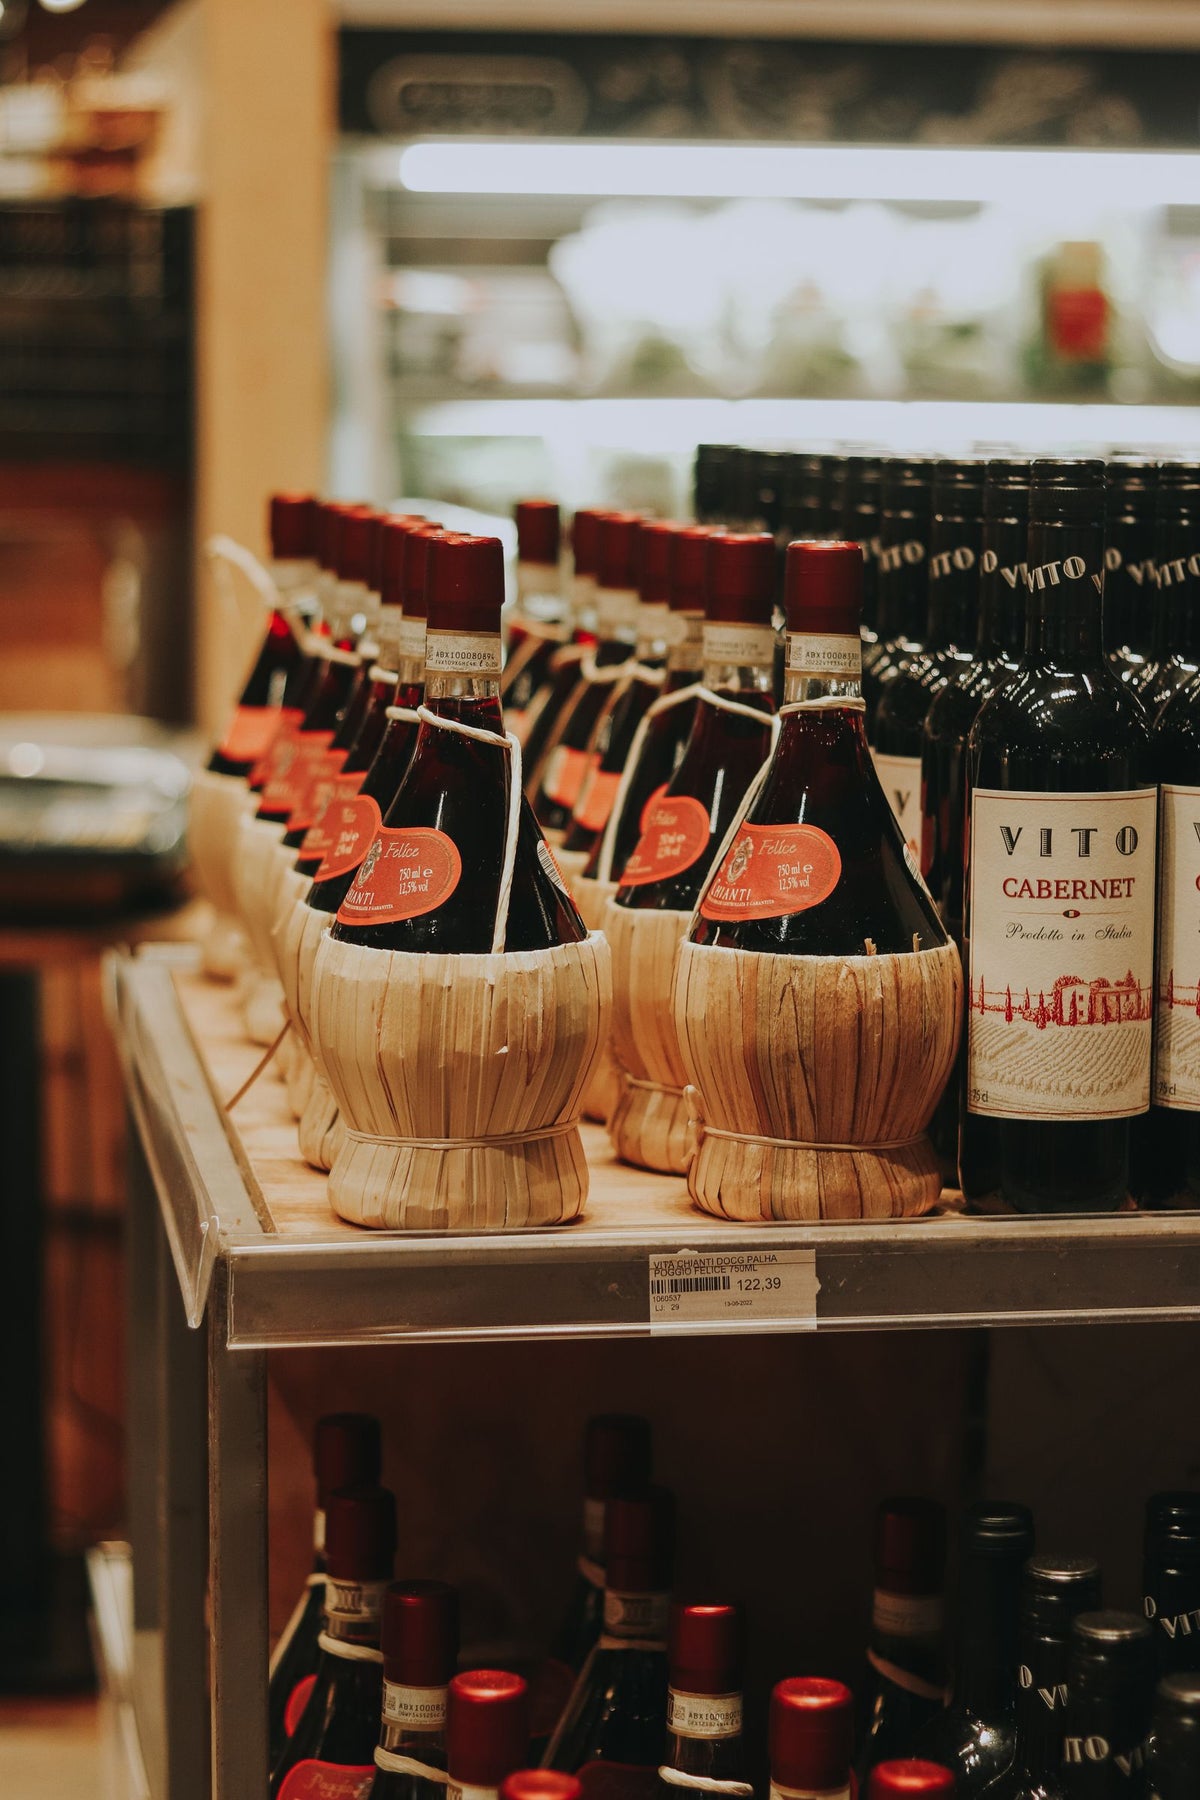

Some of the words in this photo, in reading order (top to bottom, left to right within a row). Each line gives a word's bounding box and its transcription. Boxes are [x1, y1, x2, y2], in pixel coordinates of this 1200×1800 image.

[1027, 556, 1086, 593] VITO
[757, 838, 798, 856] Felice
[999, 825, 1139, 858] VITO
[383, 842, 420, 858] Felice
[399, 868, 412, 881] 750
[411, 866, 421, 879] ml
[777, 864, 791, 877] 750
[790, 863, 801, 875] ml
[399, 882, 417, 896] 12,5%
[418, 880, 429, 893] vol
[779, 877, 798, 891] 12,5%
[798, 875, 810, 888] vol
[1002, 876, 1136, 900] CABERNET
[1005, 922, 1064, 941] Prodotto
[1071, 925, 1086, 941] in
[1094, 922, 1133, 940] Italia
[653, 1260, 675, 1269] VITA
[676, 1258, 714, 1269] CHIANTI
[716, 1256, 745, 1266] DOCG
[747, 1254, 778, 1264] PALHA
[654, 1268, 692, 1278] POGGIO
[694, 1265, 727, 1275] FELICE
[729, 1263, 758, 1273] 750ML
[737, 1277, 781, 1292] 122,39
[653, 1294, 681, 1303] 1060537
[670, 1303, 680, 1311] 29
